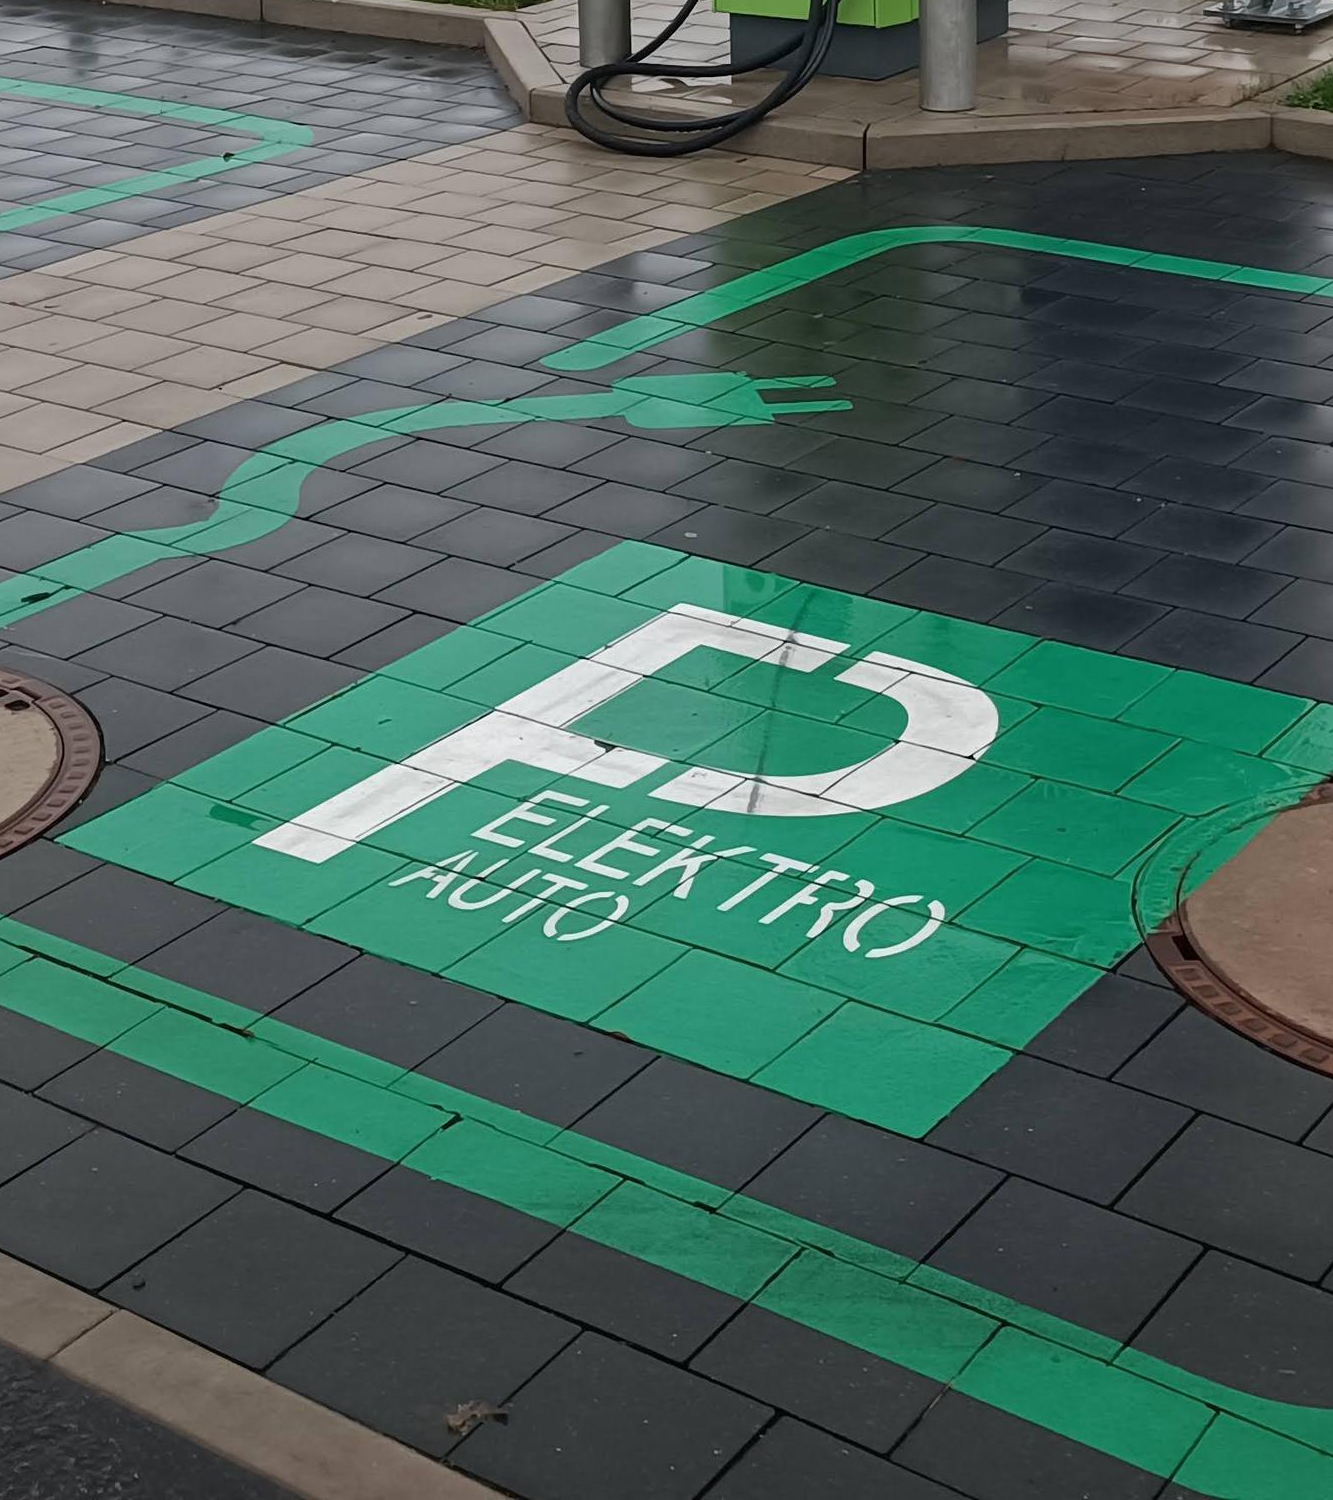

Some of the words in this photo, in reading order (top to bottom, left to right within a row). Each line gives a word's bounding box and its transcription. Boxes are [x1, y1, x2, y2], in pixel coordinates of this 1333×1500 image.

[252, 603, 999, 864] P
[388, 849, 630, 942] AUTO
[470, 788, 947, 959] ELEKTRO
